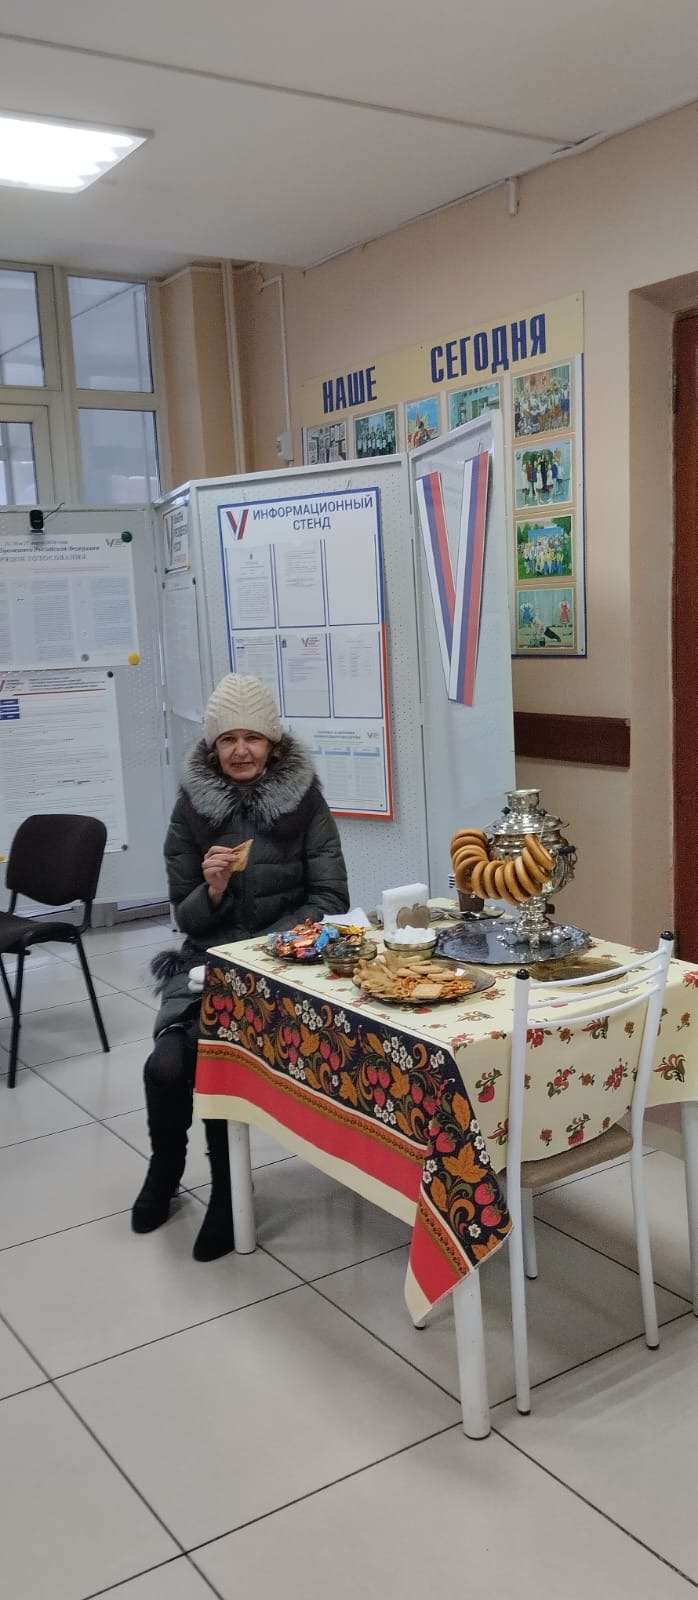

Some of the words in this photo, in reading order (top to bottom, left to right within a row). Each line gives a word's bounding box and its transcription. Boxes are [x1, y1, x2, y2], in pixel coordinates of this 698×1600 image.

[322, 366, 378, 414] НАШЕ
[430, 313, 547, 384] СЕГОДНЯ
[252, 494, 373, 521] ИНФОРМАЦИОННЫЙ
[293, 516, 331, 531] СТЕНД
